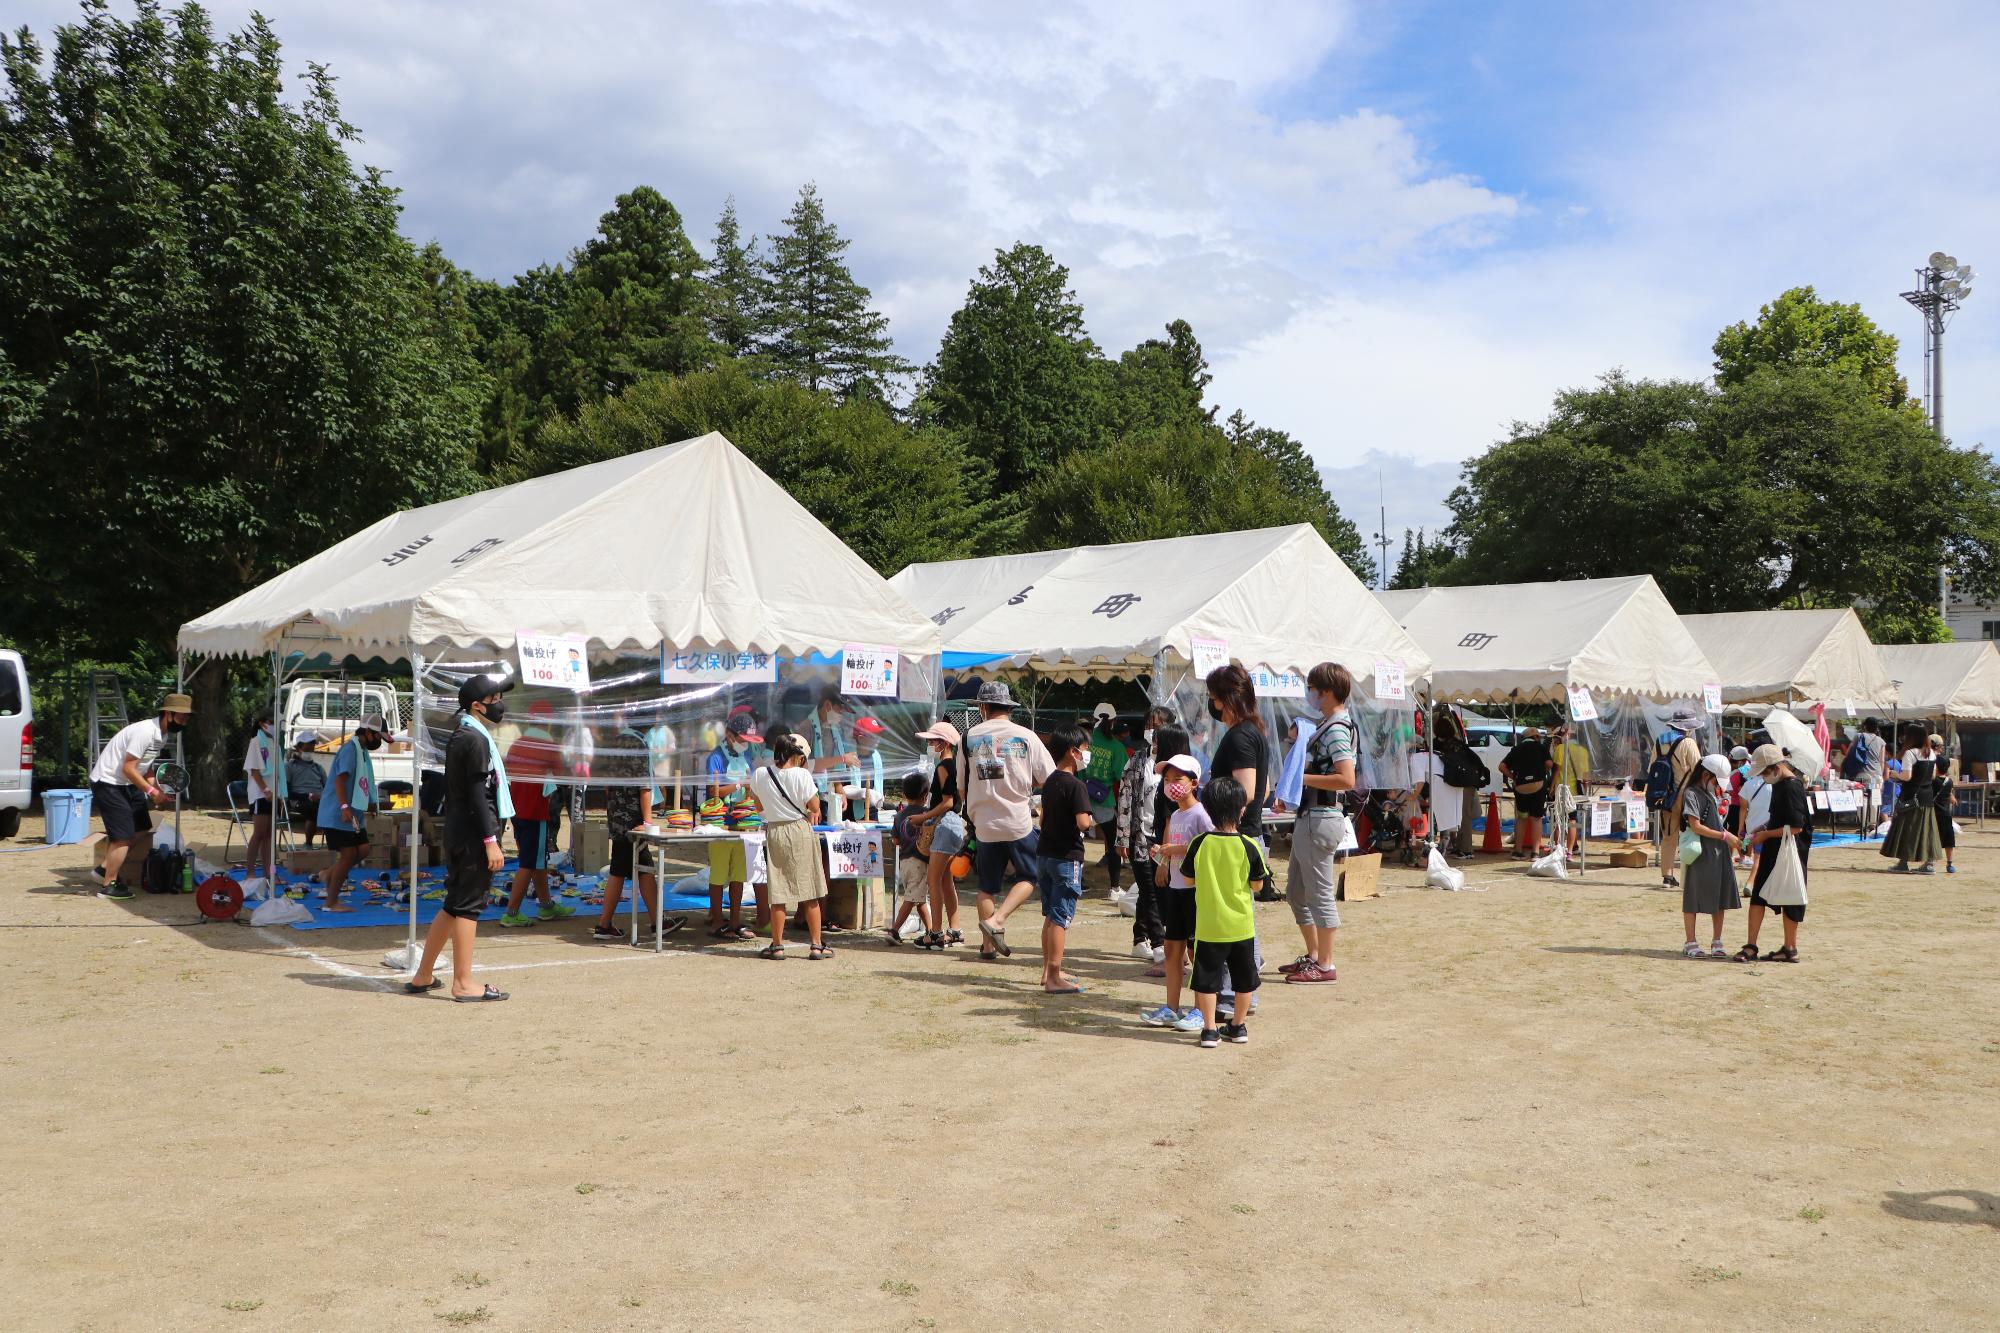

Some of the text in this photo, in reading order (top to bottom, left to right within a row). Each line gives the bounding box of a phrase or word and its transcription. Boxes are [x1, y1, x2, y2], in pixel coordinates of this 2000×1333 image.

[1457, 633, 1498, 651] 町
[523, 646, 556, 660] 輪投げ
[672, 652, 768, 671] 七久保小学校
[846, 658, 875, 670] 輪投げ
[832, 841, 861, 854] 輪投げ
